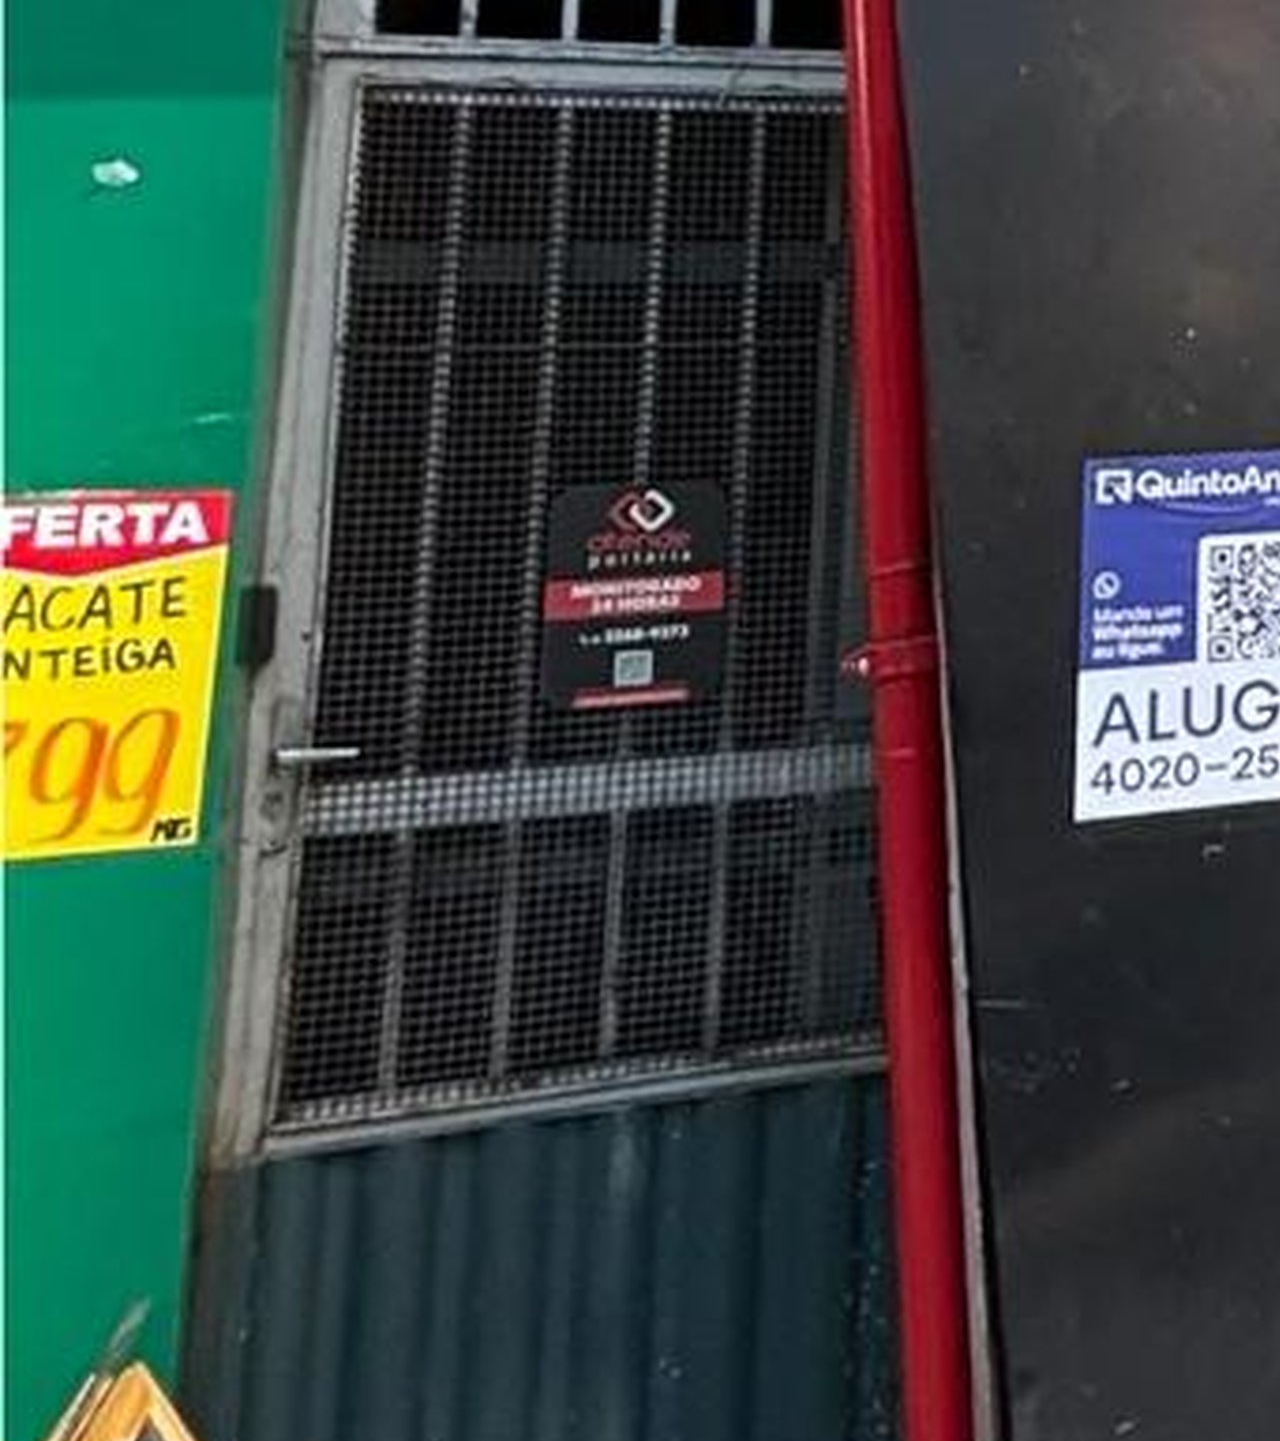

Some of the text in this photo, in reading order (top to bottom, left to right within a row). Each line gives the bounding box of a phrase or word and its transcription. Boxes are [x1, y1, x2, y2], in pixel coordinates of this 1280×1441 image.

[570, 574, 702, 600] MONITORADO
[4, 575, 187, 634] ACATE
[617, 594, 681, 613] HORAS
